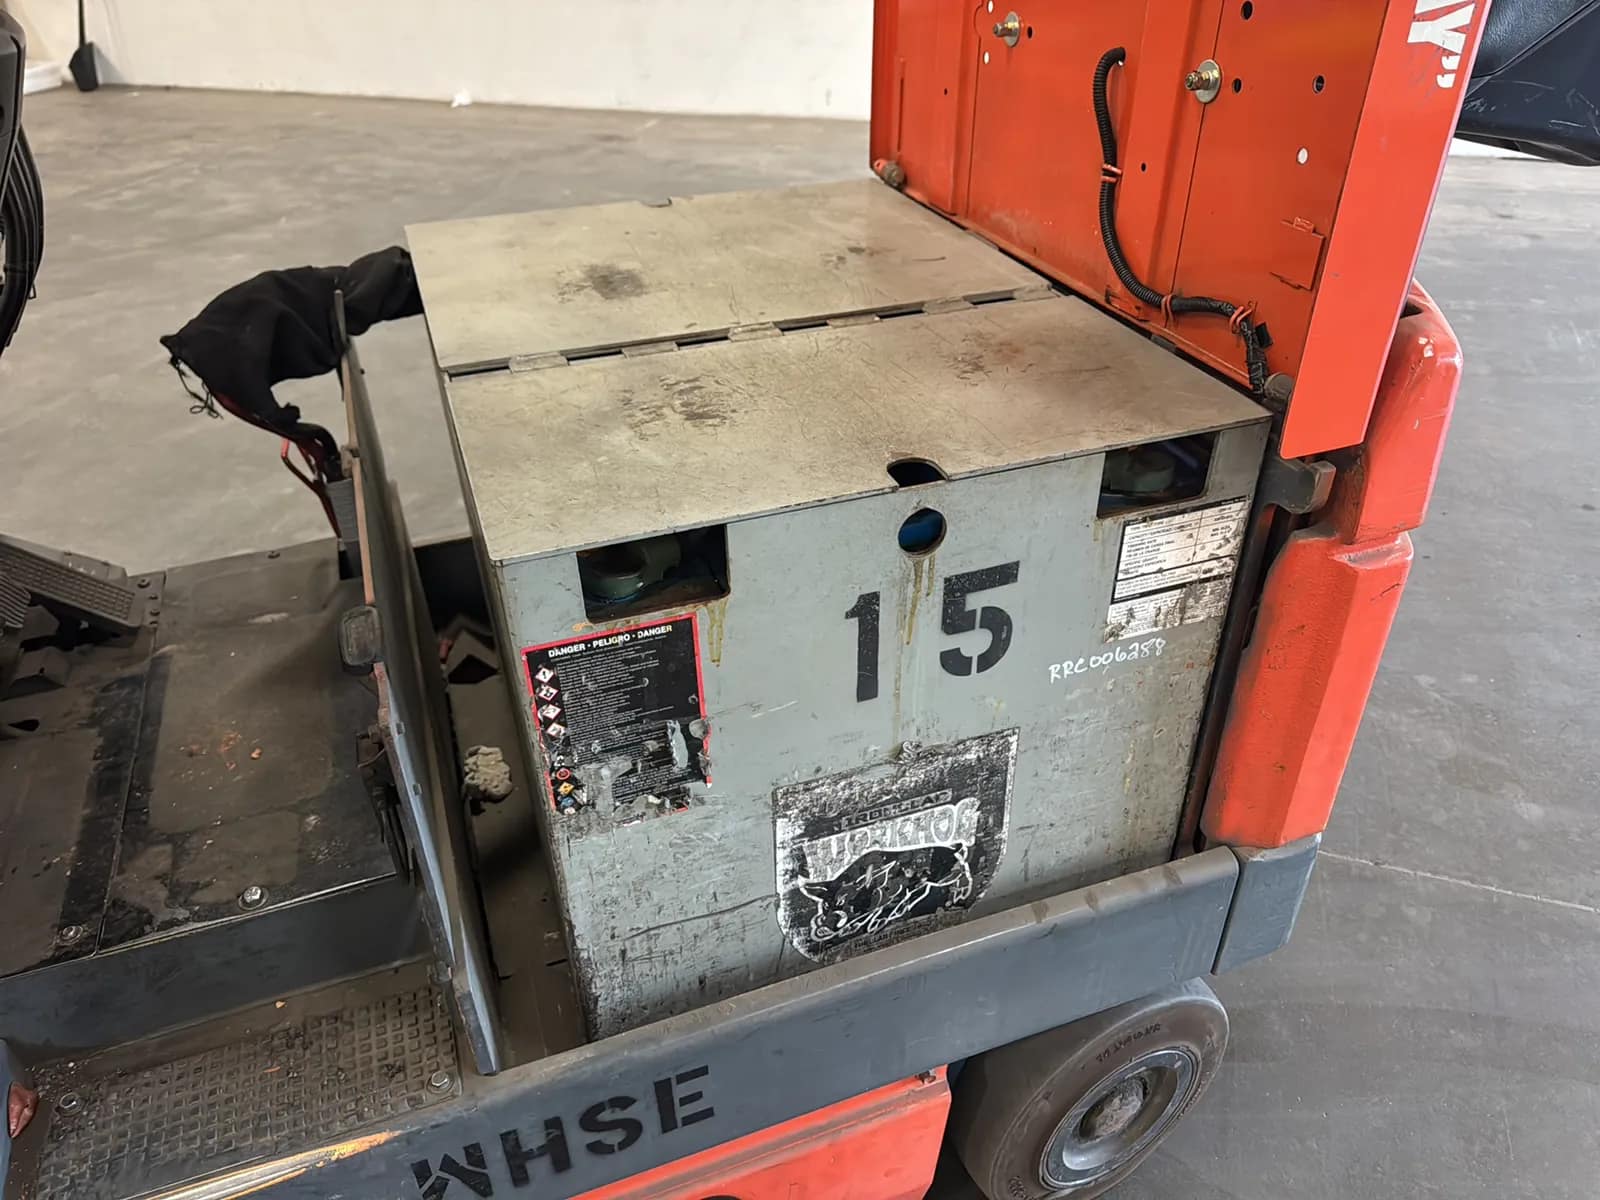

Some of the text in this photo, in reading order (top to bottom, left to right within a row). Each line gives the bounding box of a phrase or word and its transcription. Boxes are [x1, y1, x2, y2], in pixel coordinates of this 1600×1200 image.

[548, 624, 673, 658] DANGER PELIGRO DANGER
[845, 560, 1020, 702] 15
[410, 1065, 714, 1200] WHSE
